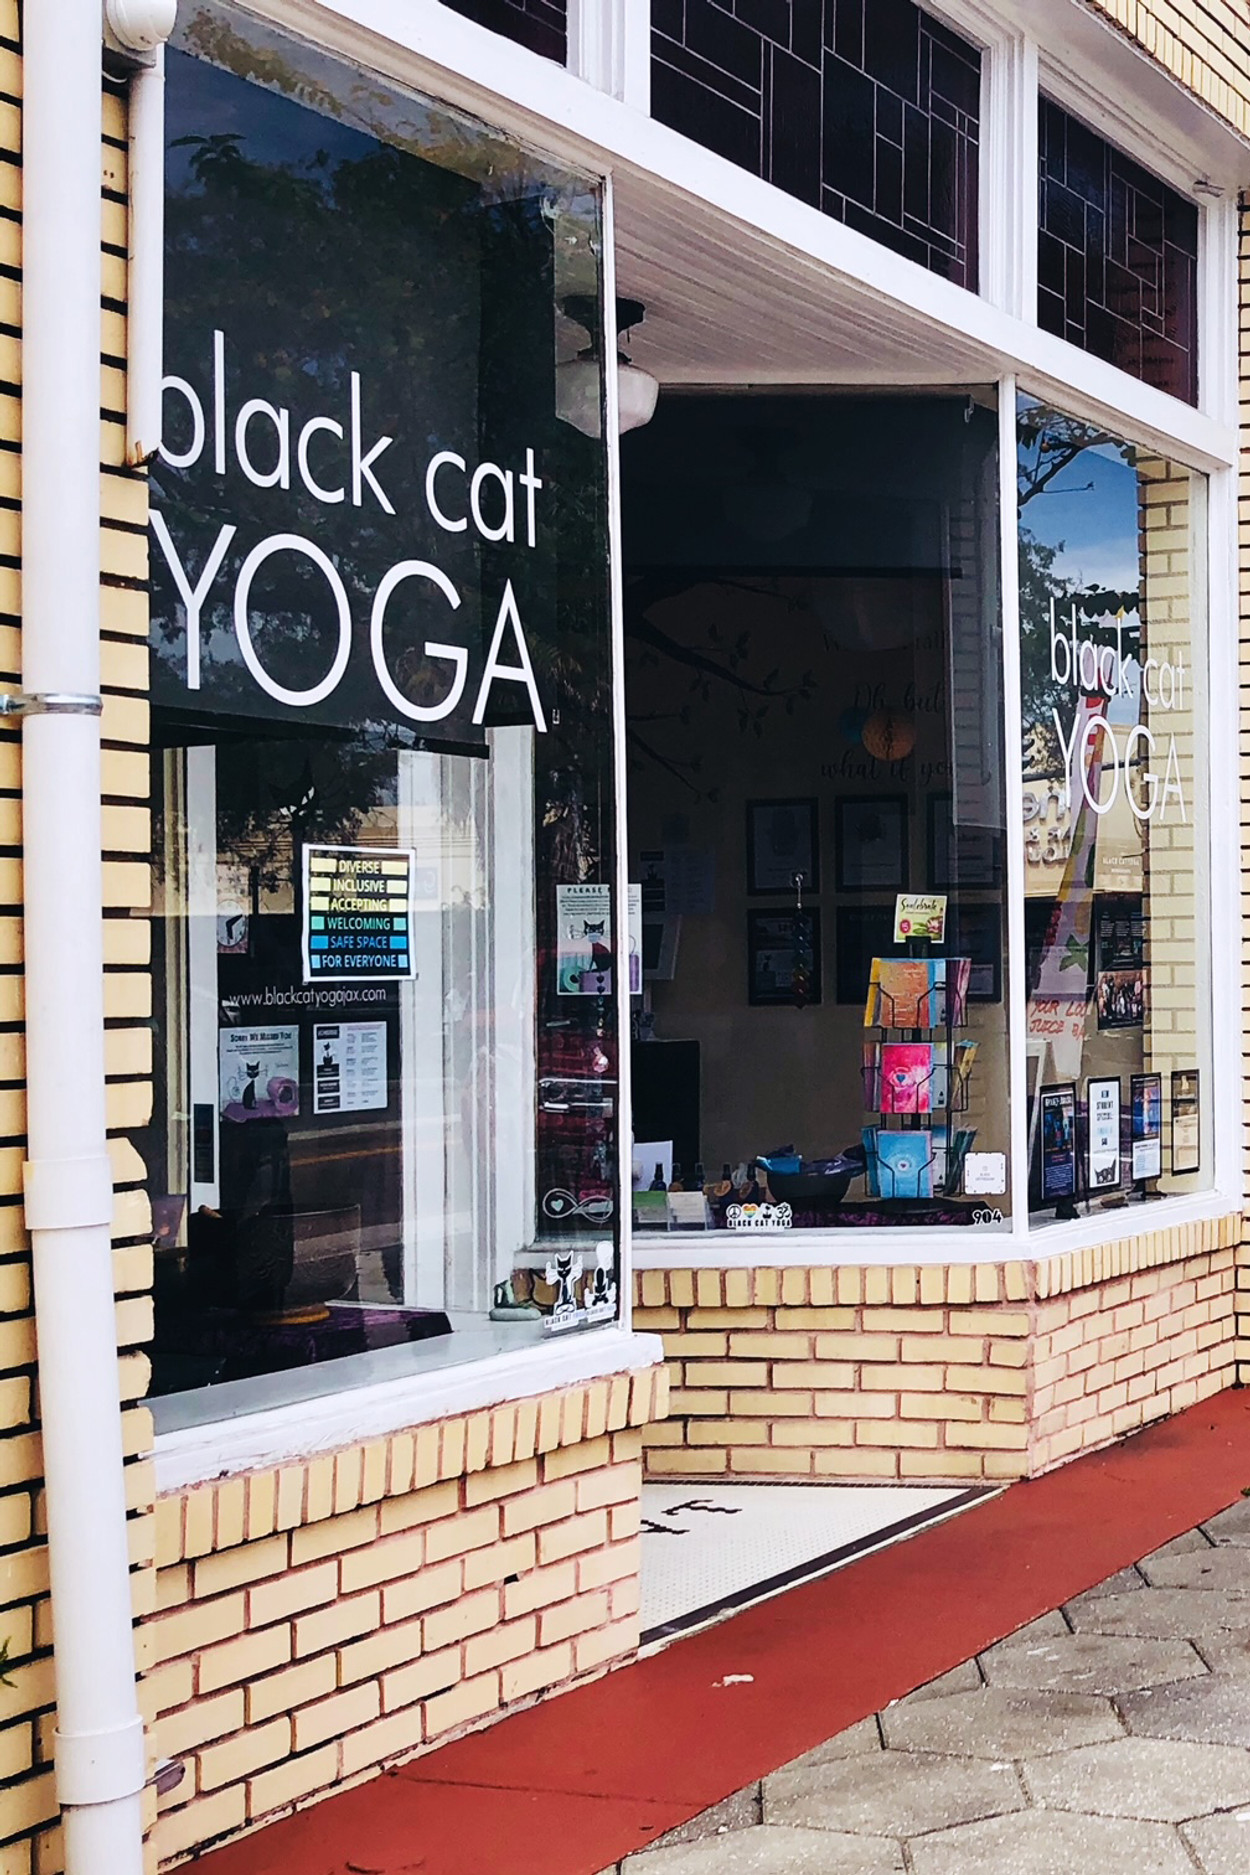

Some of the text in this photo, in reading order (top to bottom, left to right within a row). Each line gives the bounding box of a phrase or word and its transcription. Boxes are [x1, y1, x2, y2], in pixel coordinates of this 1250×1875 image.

[158, 330, 543, 548] black cat
[149, 508, 548, 732] YOGA
[1050, 596, 1185, 710] black cat
[1052, 708, 1187, 822] YOGA
[339, 860, 380, 874] DIVERSE
[332, 878, 385, 893] INCLUSIVE
[331, 898, 387, 912] ACCEPTING
[327, 917, 391, 930] WELCOMING
[330, 936, 387, 949] SAFE SPACE
[322, 955, 397, 967] FOR EVERYONE
[229, 985, 386, 1007] www.blackcatyogajax.com
[972, 1209, 1002, 1226] 904
